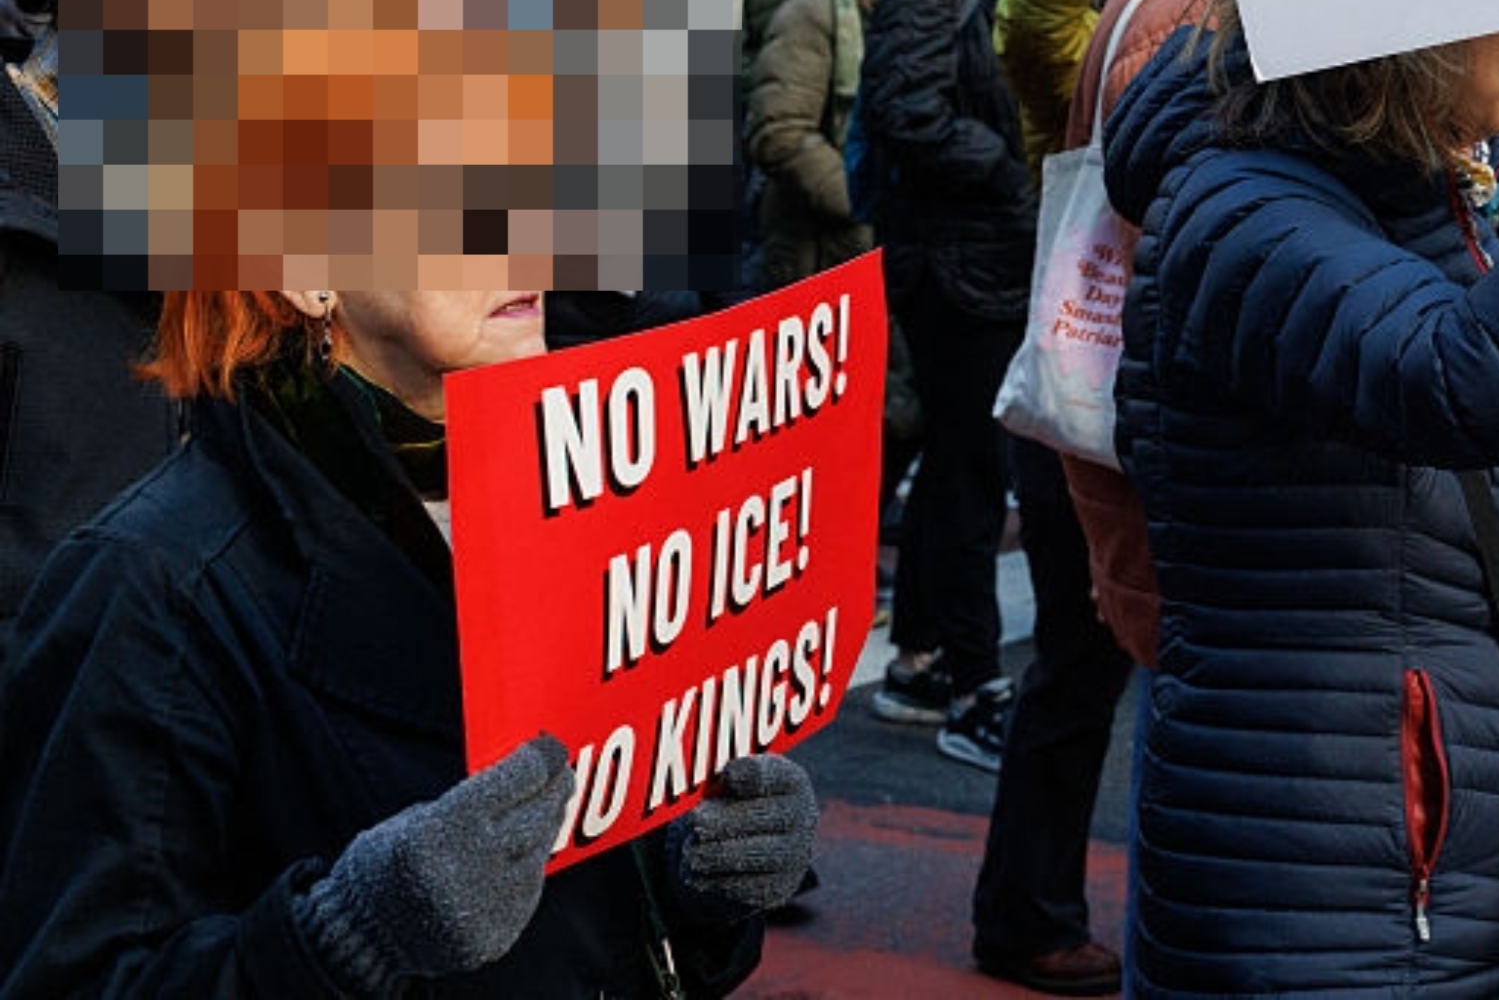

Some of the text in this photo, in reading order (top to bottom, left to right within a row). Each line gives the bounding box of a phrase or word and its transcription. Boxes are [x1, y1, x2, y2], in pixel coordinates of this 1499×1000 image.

[1085, 285, 1120, 308] Day
[537, 294, 851, 513] NO WARS!
[606, 467, 814, 673] NO ICE!
[647, 608, 838, 810] KINGS!
